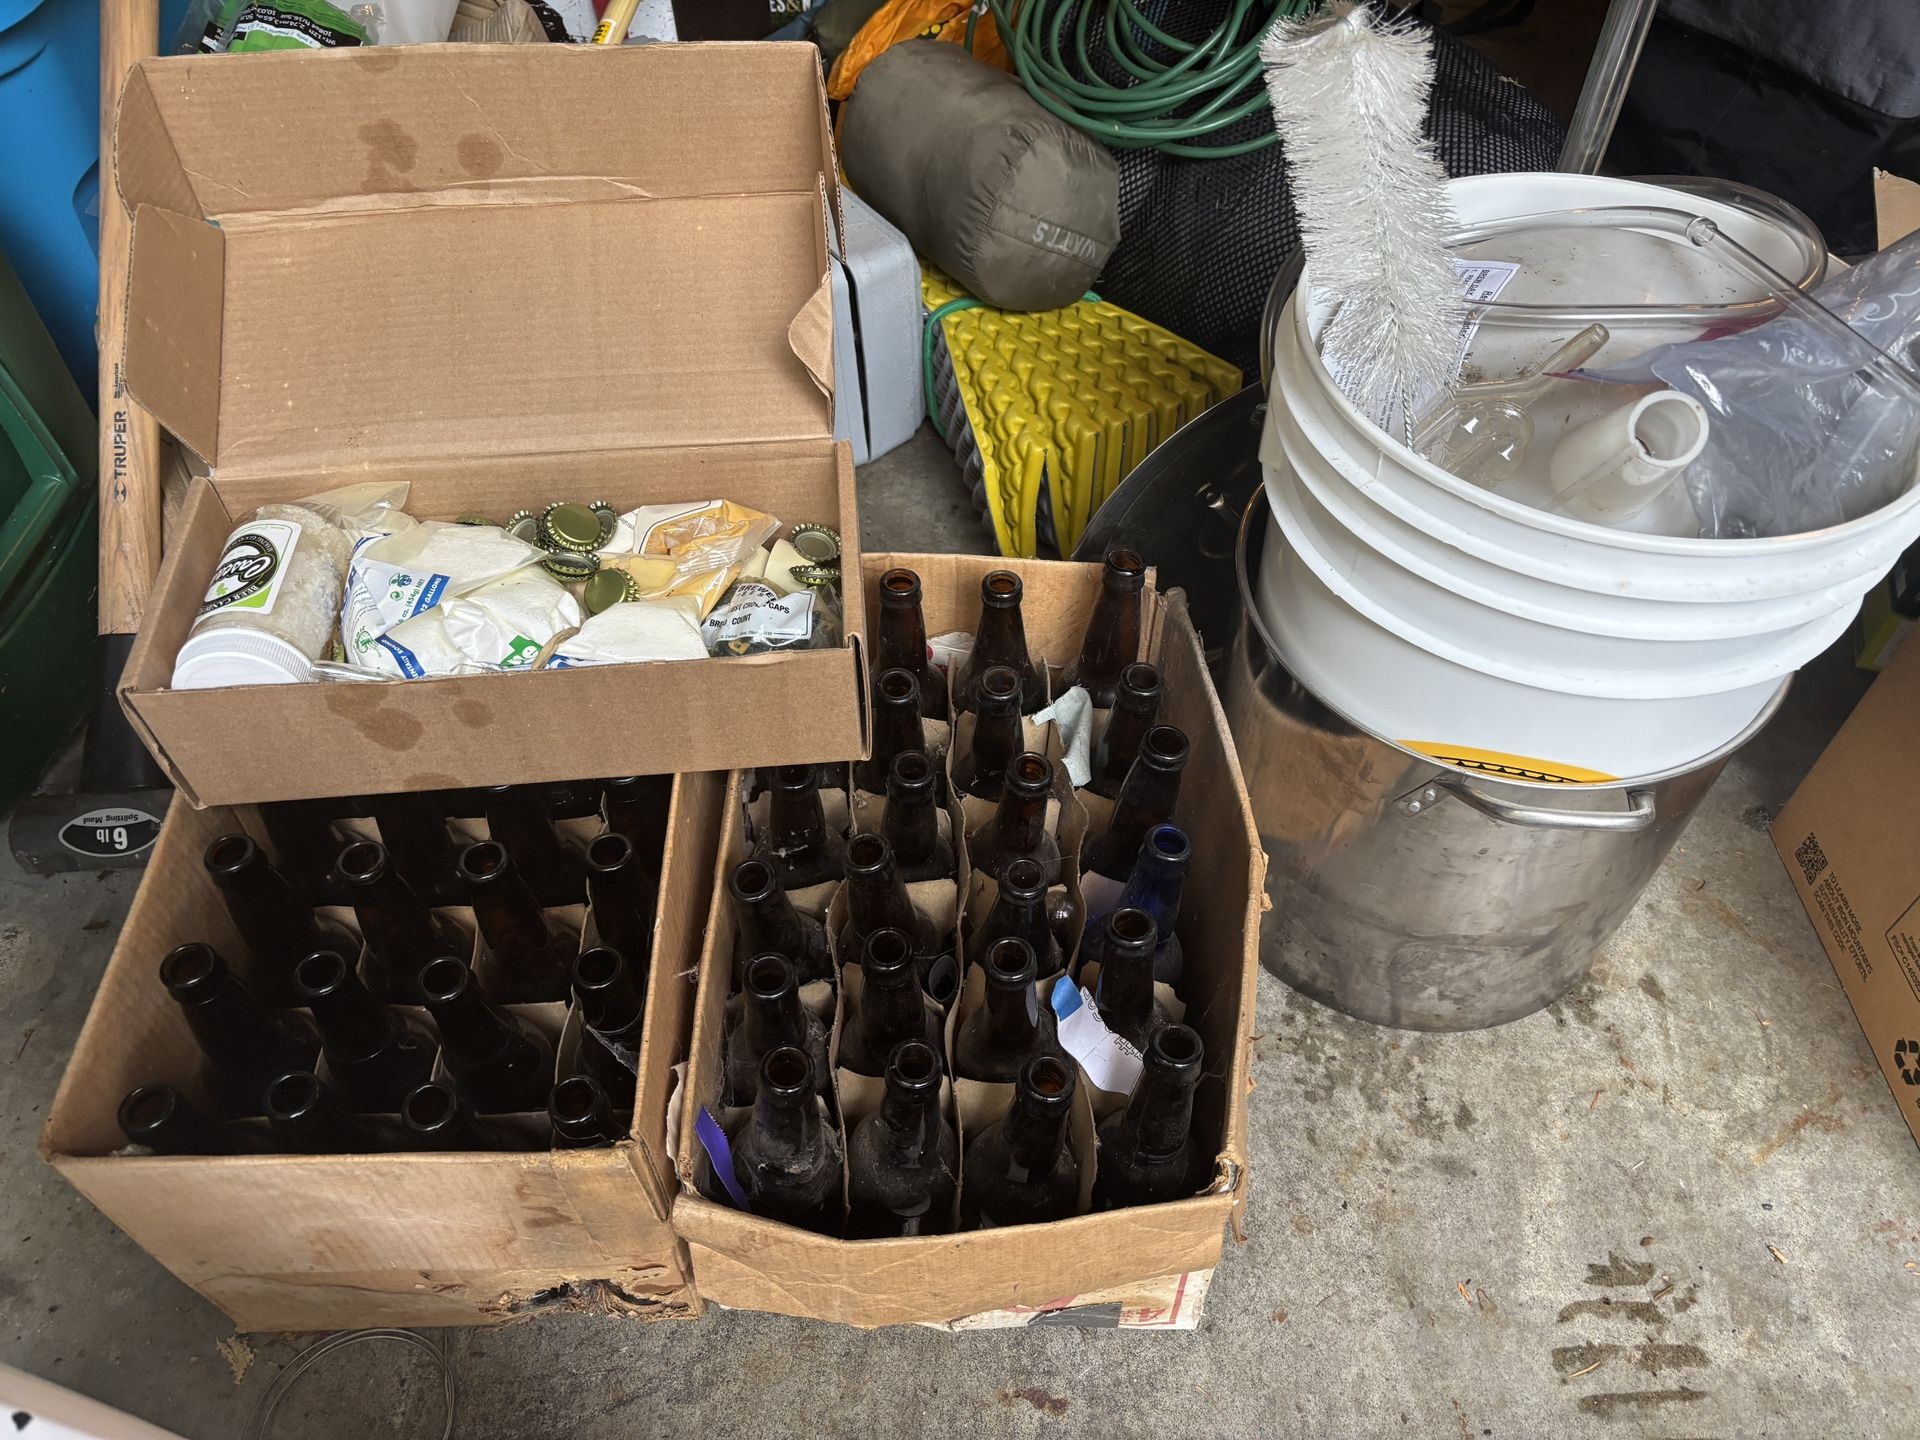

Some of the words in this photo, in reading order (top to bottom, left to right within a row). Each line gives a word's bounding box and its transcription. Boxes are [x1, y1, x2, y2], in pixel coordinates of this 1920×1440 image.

[1032, 222, 1097, 260] WATTS
[1465, 283, 1480, 296] DAY
[113, 410, 127, 480] TRUPER
[233, 585, 259, 599] BEER
[425, 577, 442, 604] GALLONS
[731, 613, 752, 625] COUNT
[768, 602, 790, 614] CAPS
[83, 816, 103, 824] Maul
[105, 813, 139, 822] Splitting
[96, 828, 110, 843] lb
[113, 827, 128, 850] 6
[1823, 878, 1839, 905] ABOUT
[1837, 903, 1849, 926] IRON
[1829, 871, 1837, 883] TO
[1834, 882, 1850, 910] LEARN
[1848, 908, 1862, 935] MORE
[1812, 888, 1826, 913] SCAN
[1823, 911, 1835, 931] THIS
[1832, 929, 1846, 954] CODE
[1817, 884, 1850, 945] SUSTAINABILITY
